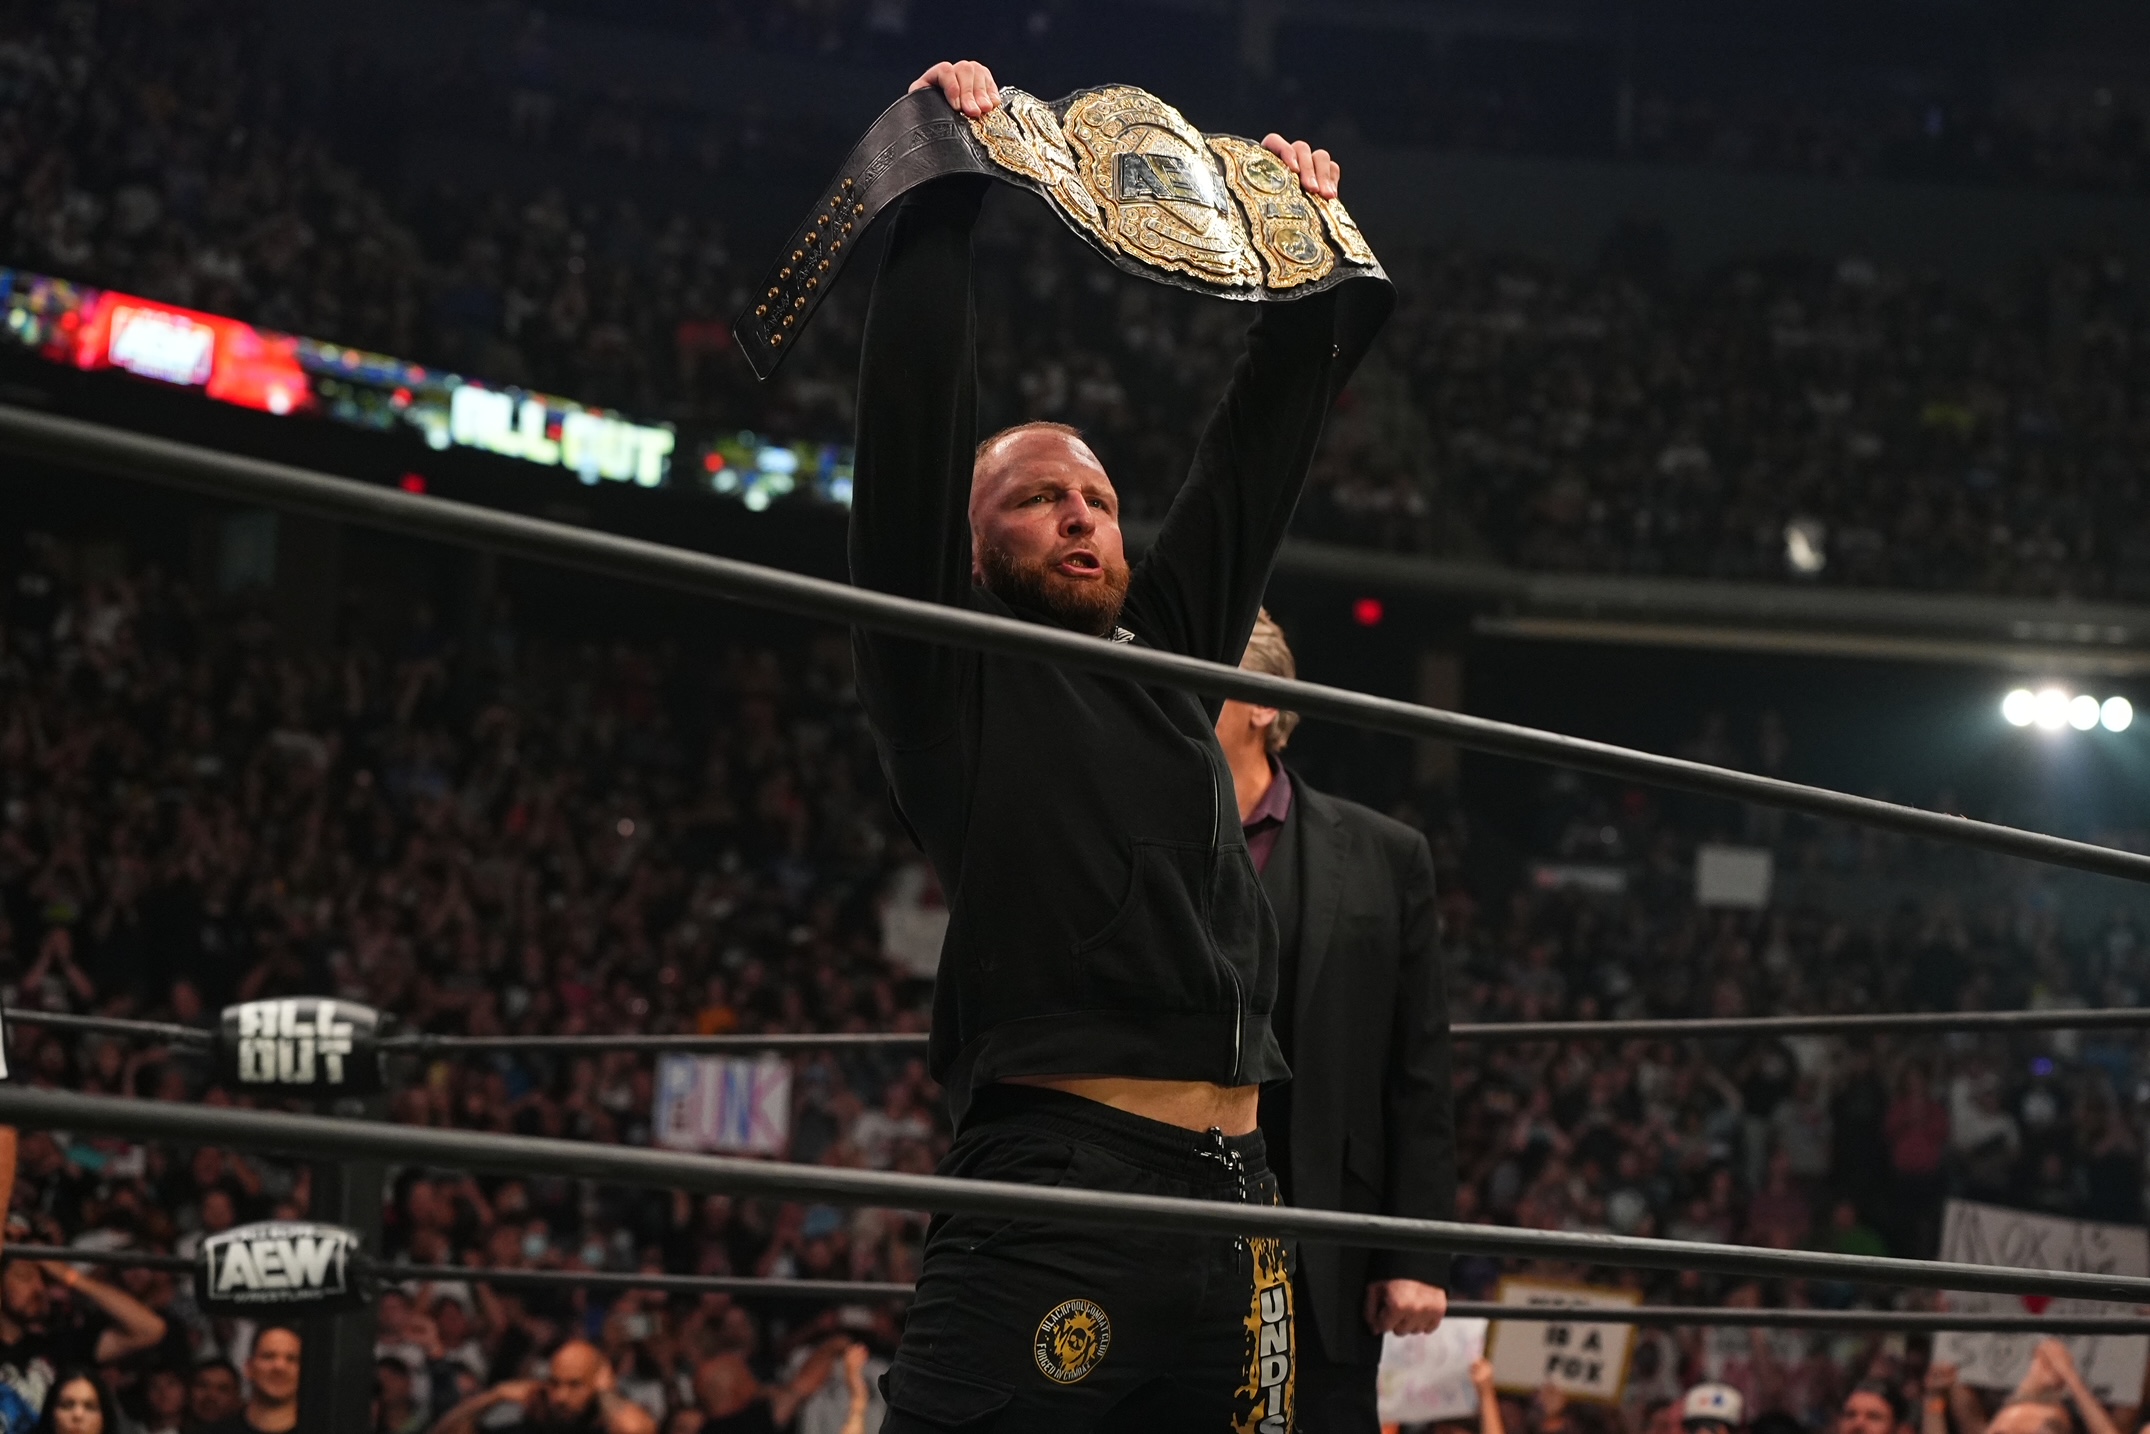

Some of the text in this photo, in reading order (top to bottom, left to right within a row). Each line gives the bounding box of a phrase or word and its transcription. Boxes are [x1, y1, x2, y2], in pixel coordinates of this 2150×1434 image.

[238, 1000, 353, 1038] ALL
[238, 1037, 352, 1084] OUT
[217, 1237, 337, 1291] AEW
[1041, 1301, 1085, 1333] BLACKPOOL
[1036, 1343, 1057, 1375] FORGED
